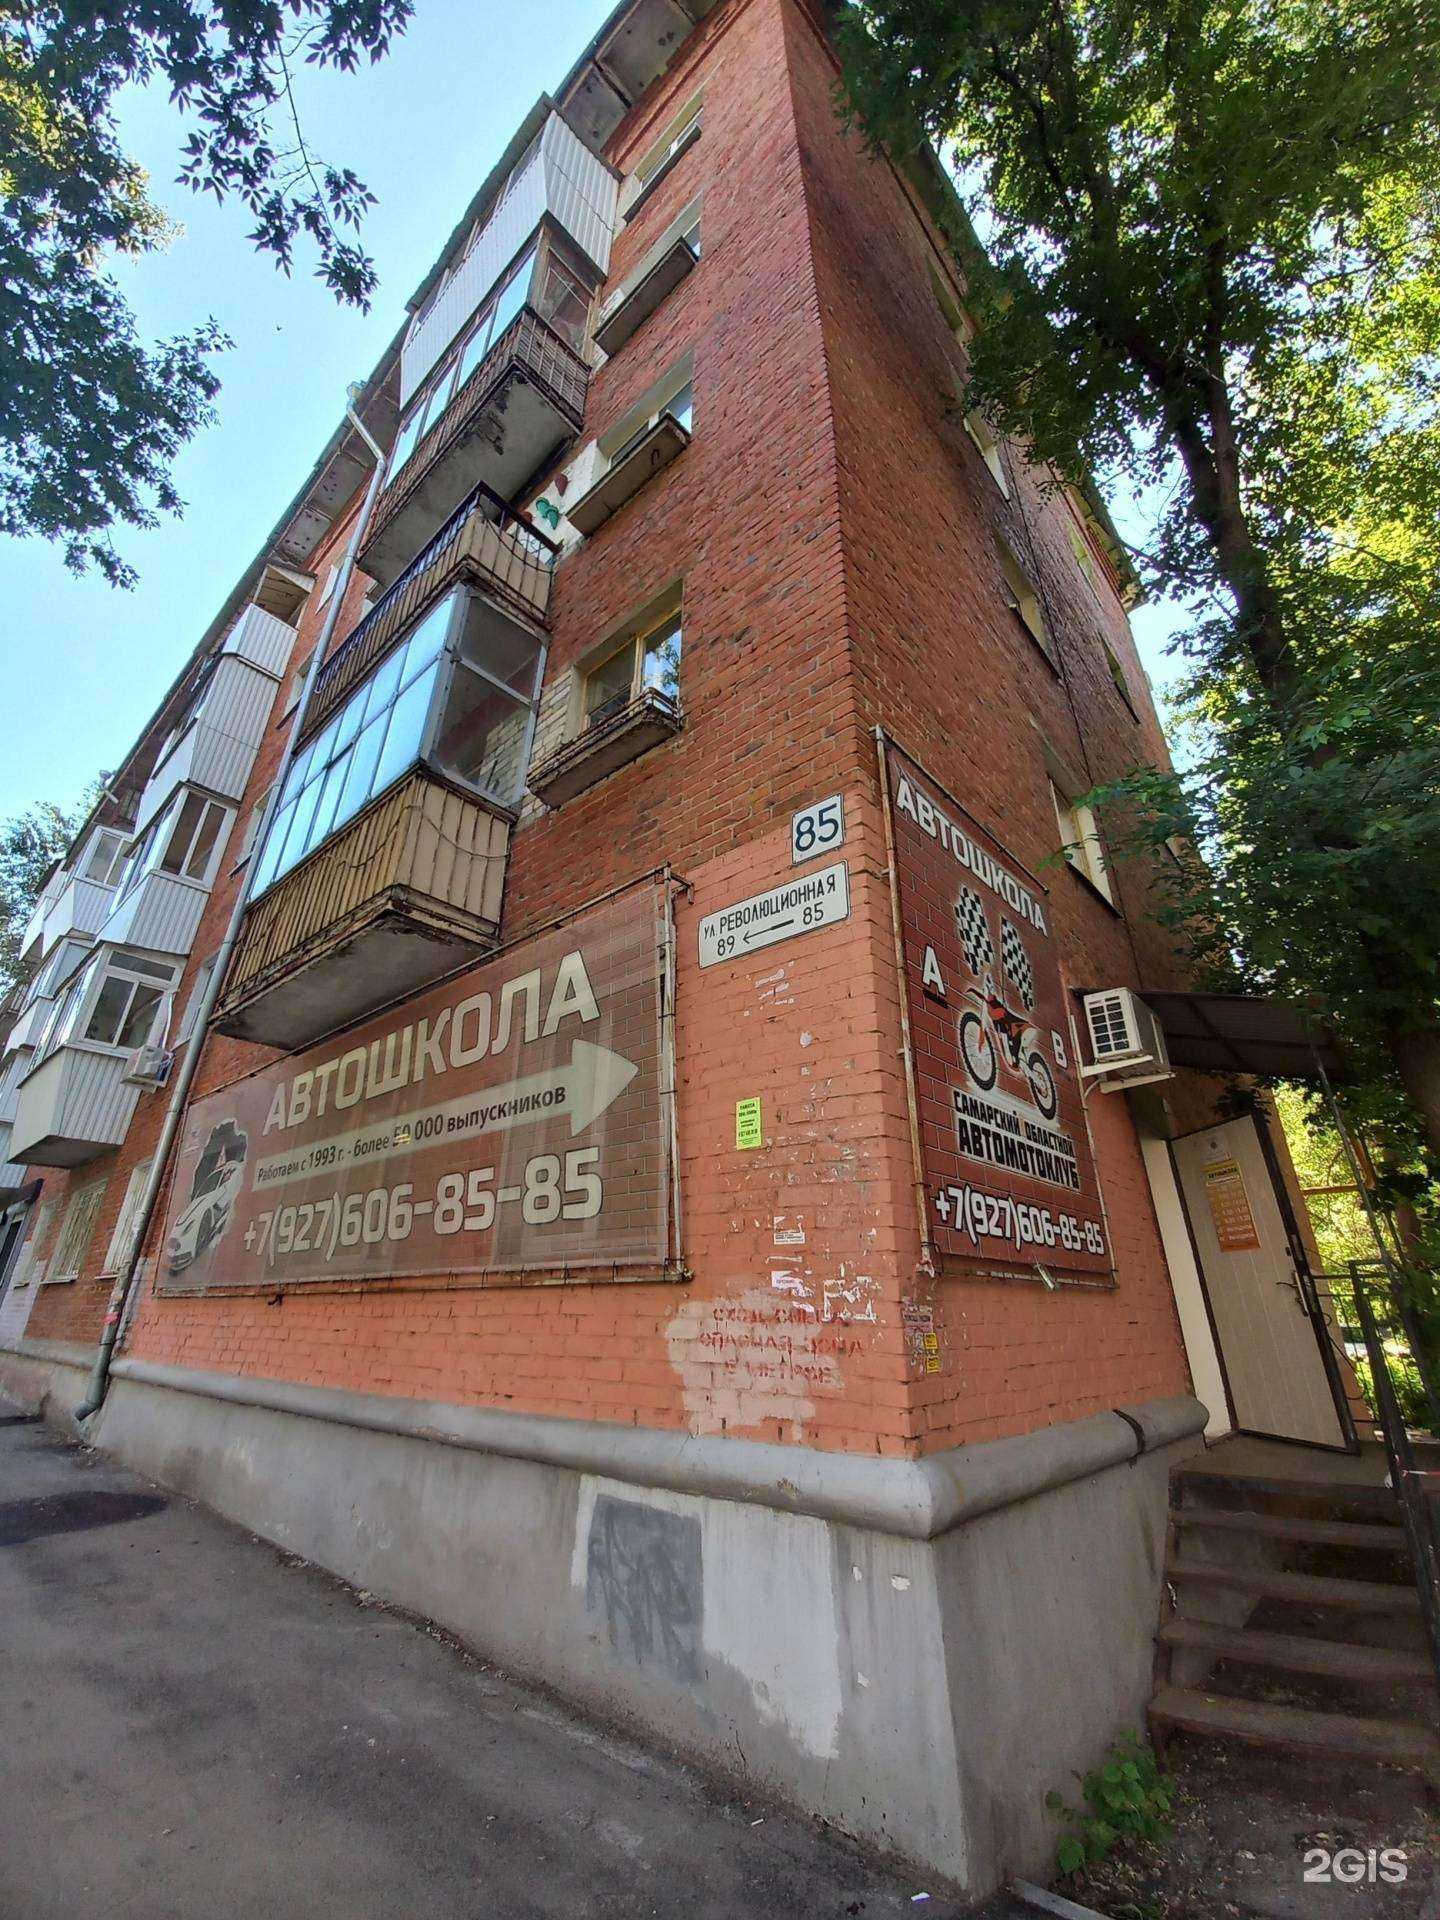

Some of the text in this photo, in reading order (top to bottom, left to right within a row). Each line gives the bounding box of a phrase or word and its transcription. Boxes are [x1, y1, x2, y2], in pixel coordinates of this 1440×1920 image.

[795, 803, 839, 851] 85
[897, 777, 1048, 938] АВТОШКОЛА
[704, 874, 836, 940] УЛ. РЕВОЛЮЦИОННАЯ
[802, 902, 824, 925] 85
[717, 935, 735, 956] 89
[262, 949, 600, 1136] АВТОШКОЛА
[257, 1161, 299, 1181] Работаем
[308, 1145, 336, 1169] 1993
[354, 1135, 390, 1157] более
[414, 1114, 444, 1141] 000
[447, 1086, 567, 1133] выпускников
[953, 1089, 1076, 1158] САМАРСКИЙ ОБЛАСТНОЙ
[957, 1117, 1081, 1190] АВТОМОТОКЛУБ
[243, 1147, 604, 1266] +7(927)606-85-85
[934, 1183, 1105, 1255] +7(927)606-85-85
